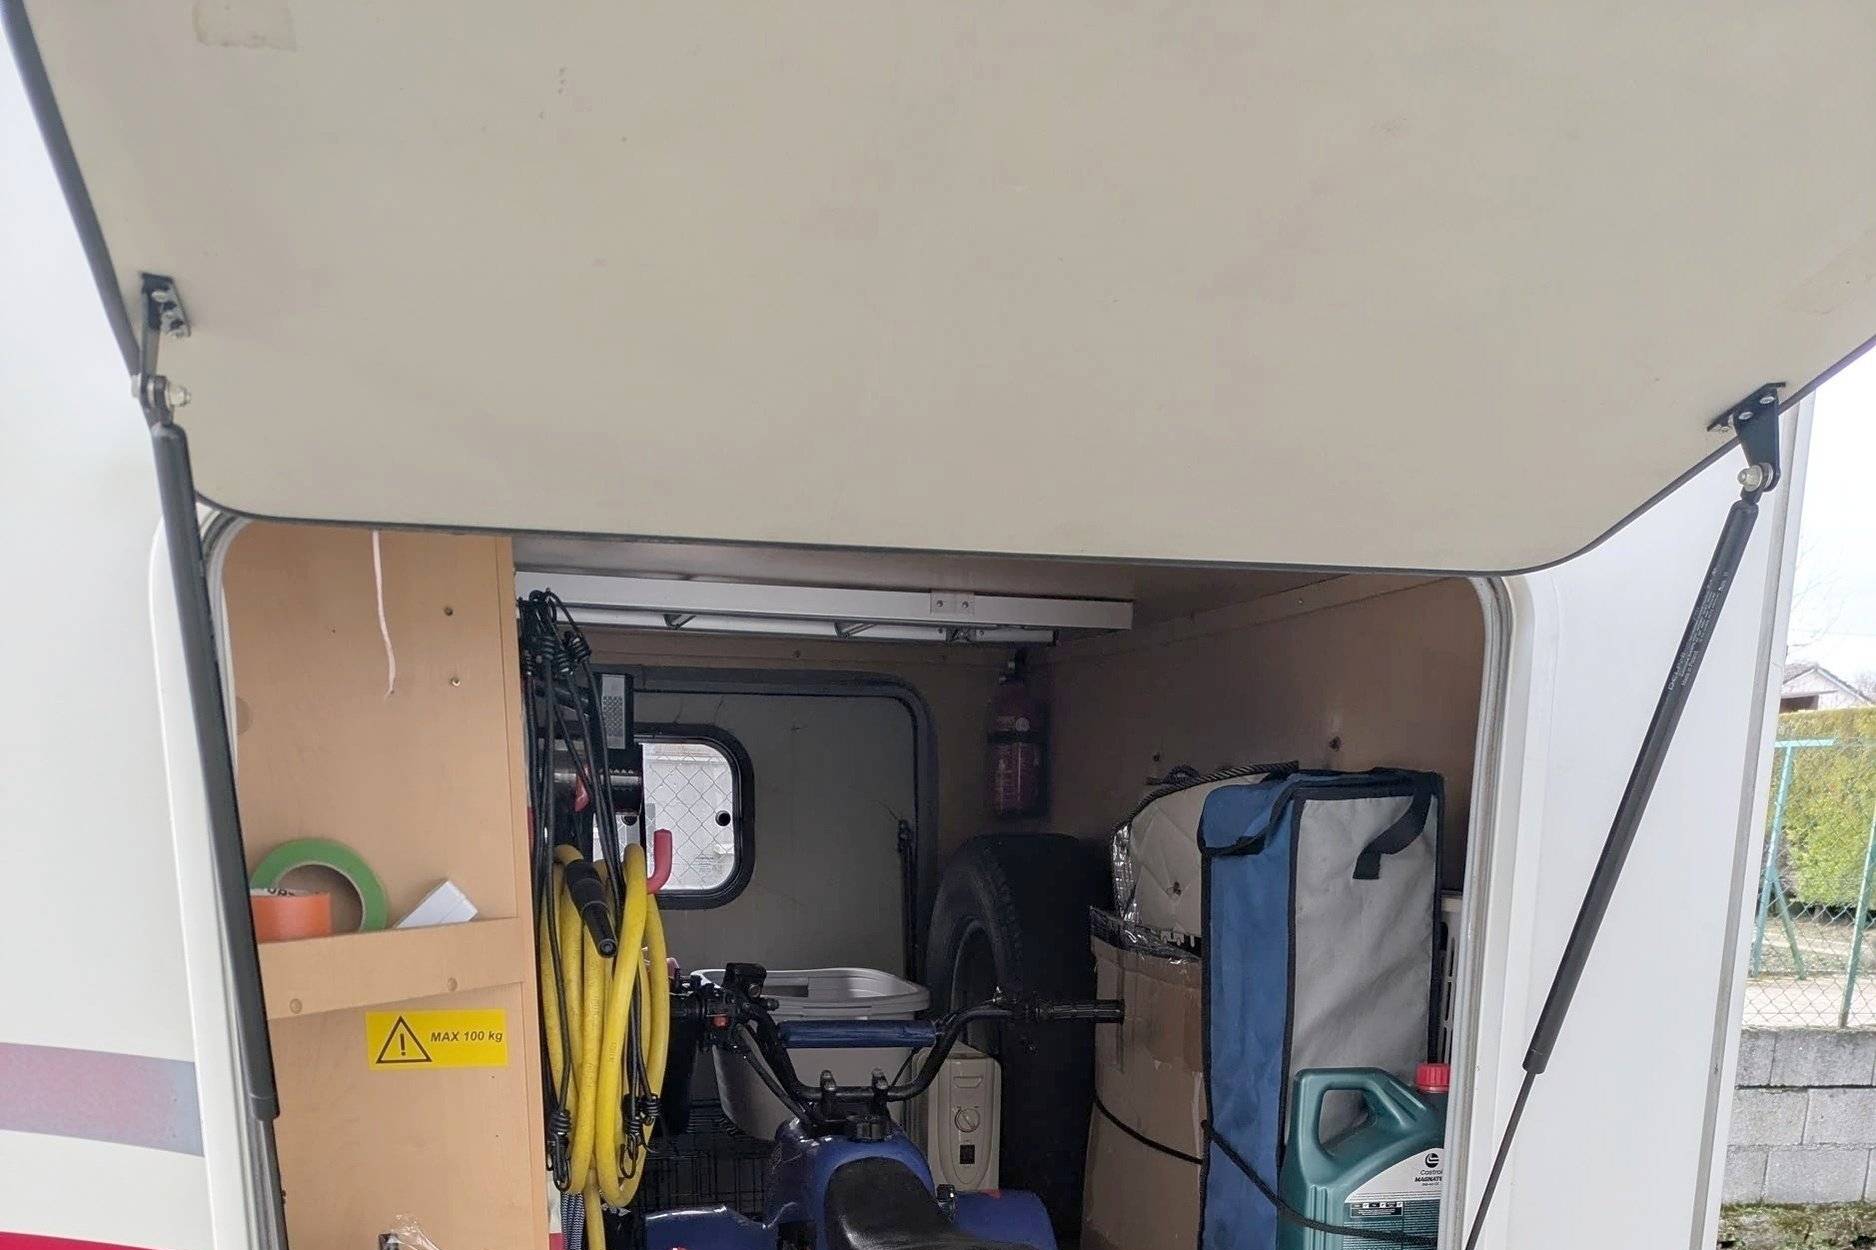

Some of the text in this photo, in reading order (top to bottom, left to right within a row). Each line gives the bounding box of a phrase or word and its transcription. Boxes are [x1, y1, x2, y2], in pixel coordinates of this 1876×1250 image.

[430, 1030, 503, 1042] MAX 100 kg
